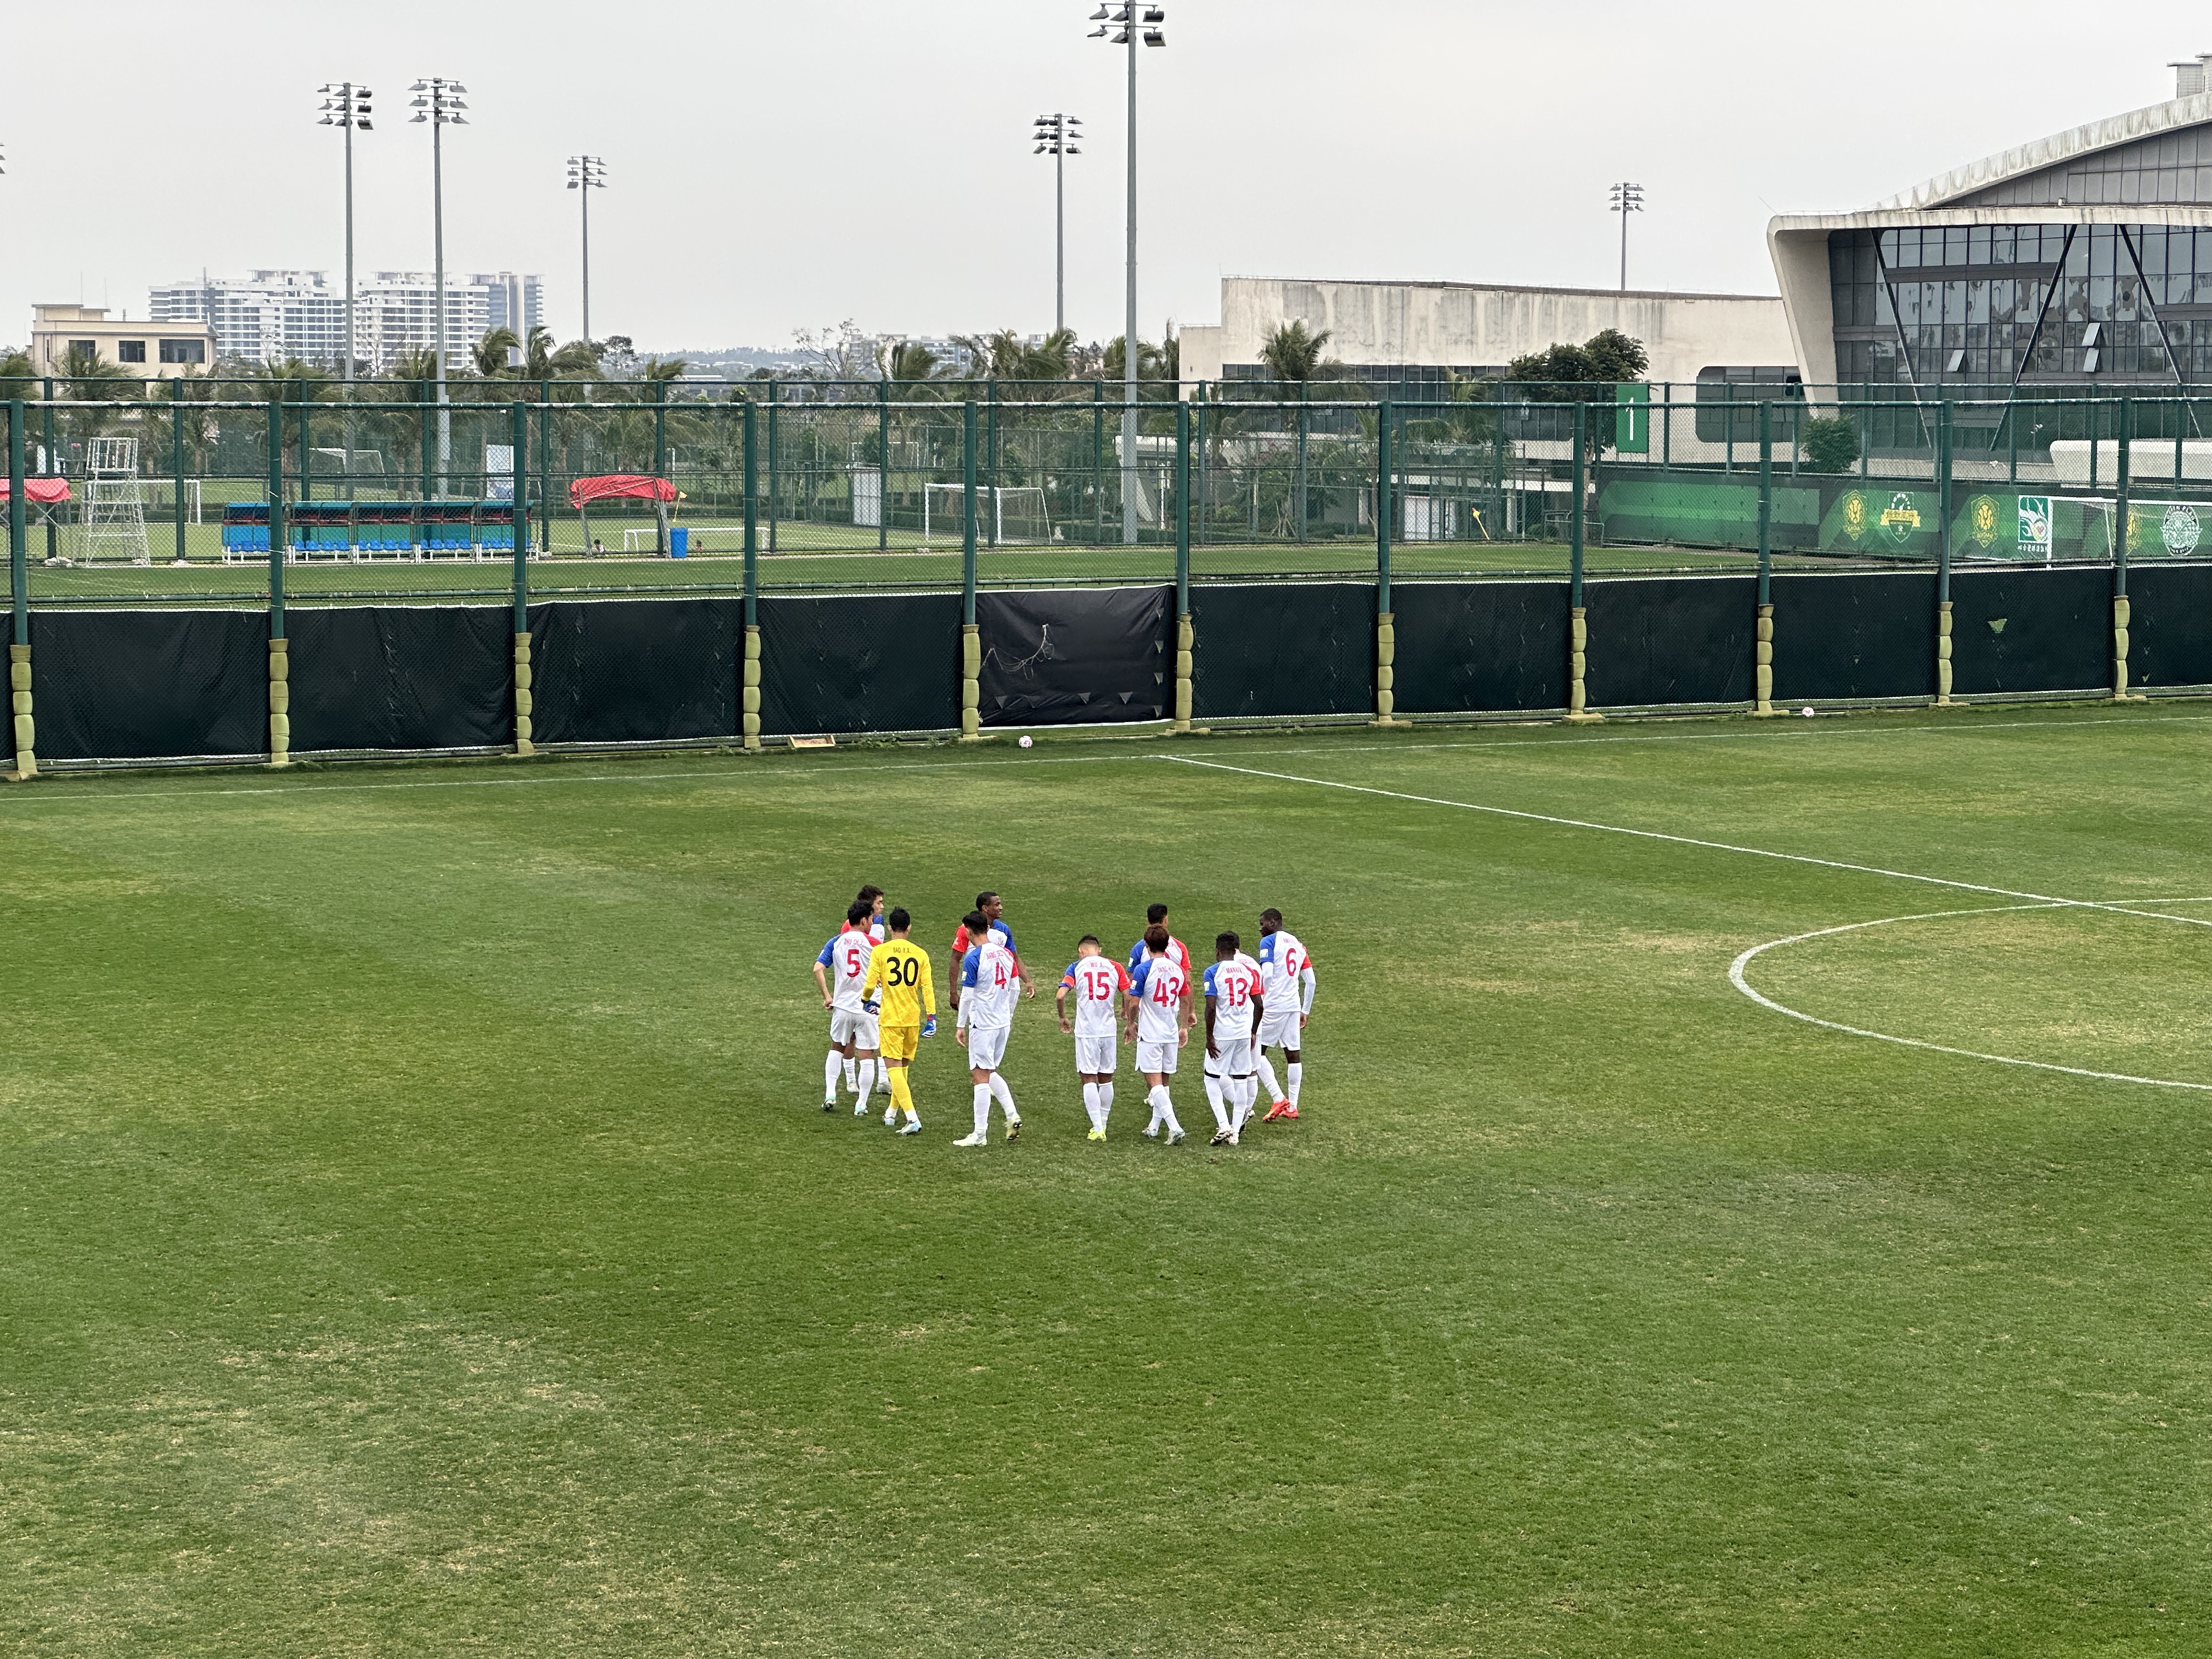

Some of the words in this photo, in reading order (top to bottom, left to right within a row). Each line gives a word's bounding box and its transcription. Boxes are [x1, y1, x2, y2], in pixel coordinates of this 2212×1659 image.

[1626, 397, 1634, 441] 1
[847, 949, 860, 977] 5
[887, 956, 918, 986] 30
[995, 962, 1007, 989] 4
[1286, 948, 1296, 977] 6
[1084, 972, 1110, 1001] 15
[1153, 977, 1180, 1007] 43
[1224, 978, 1248, 1006] 13
